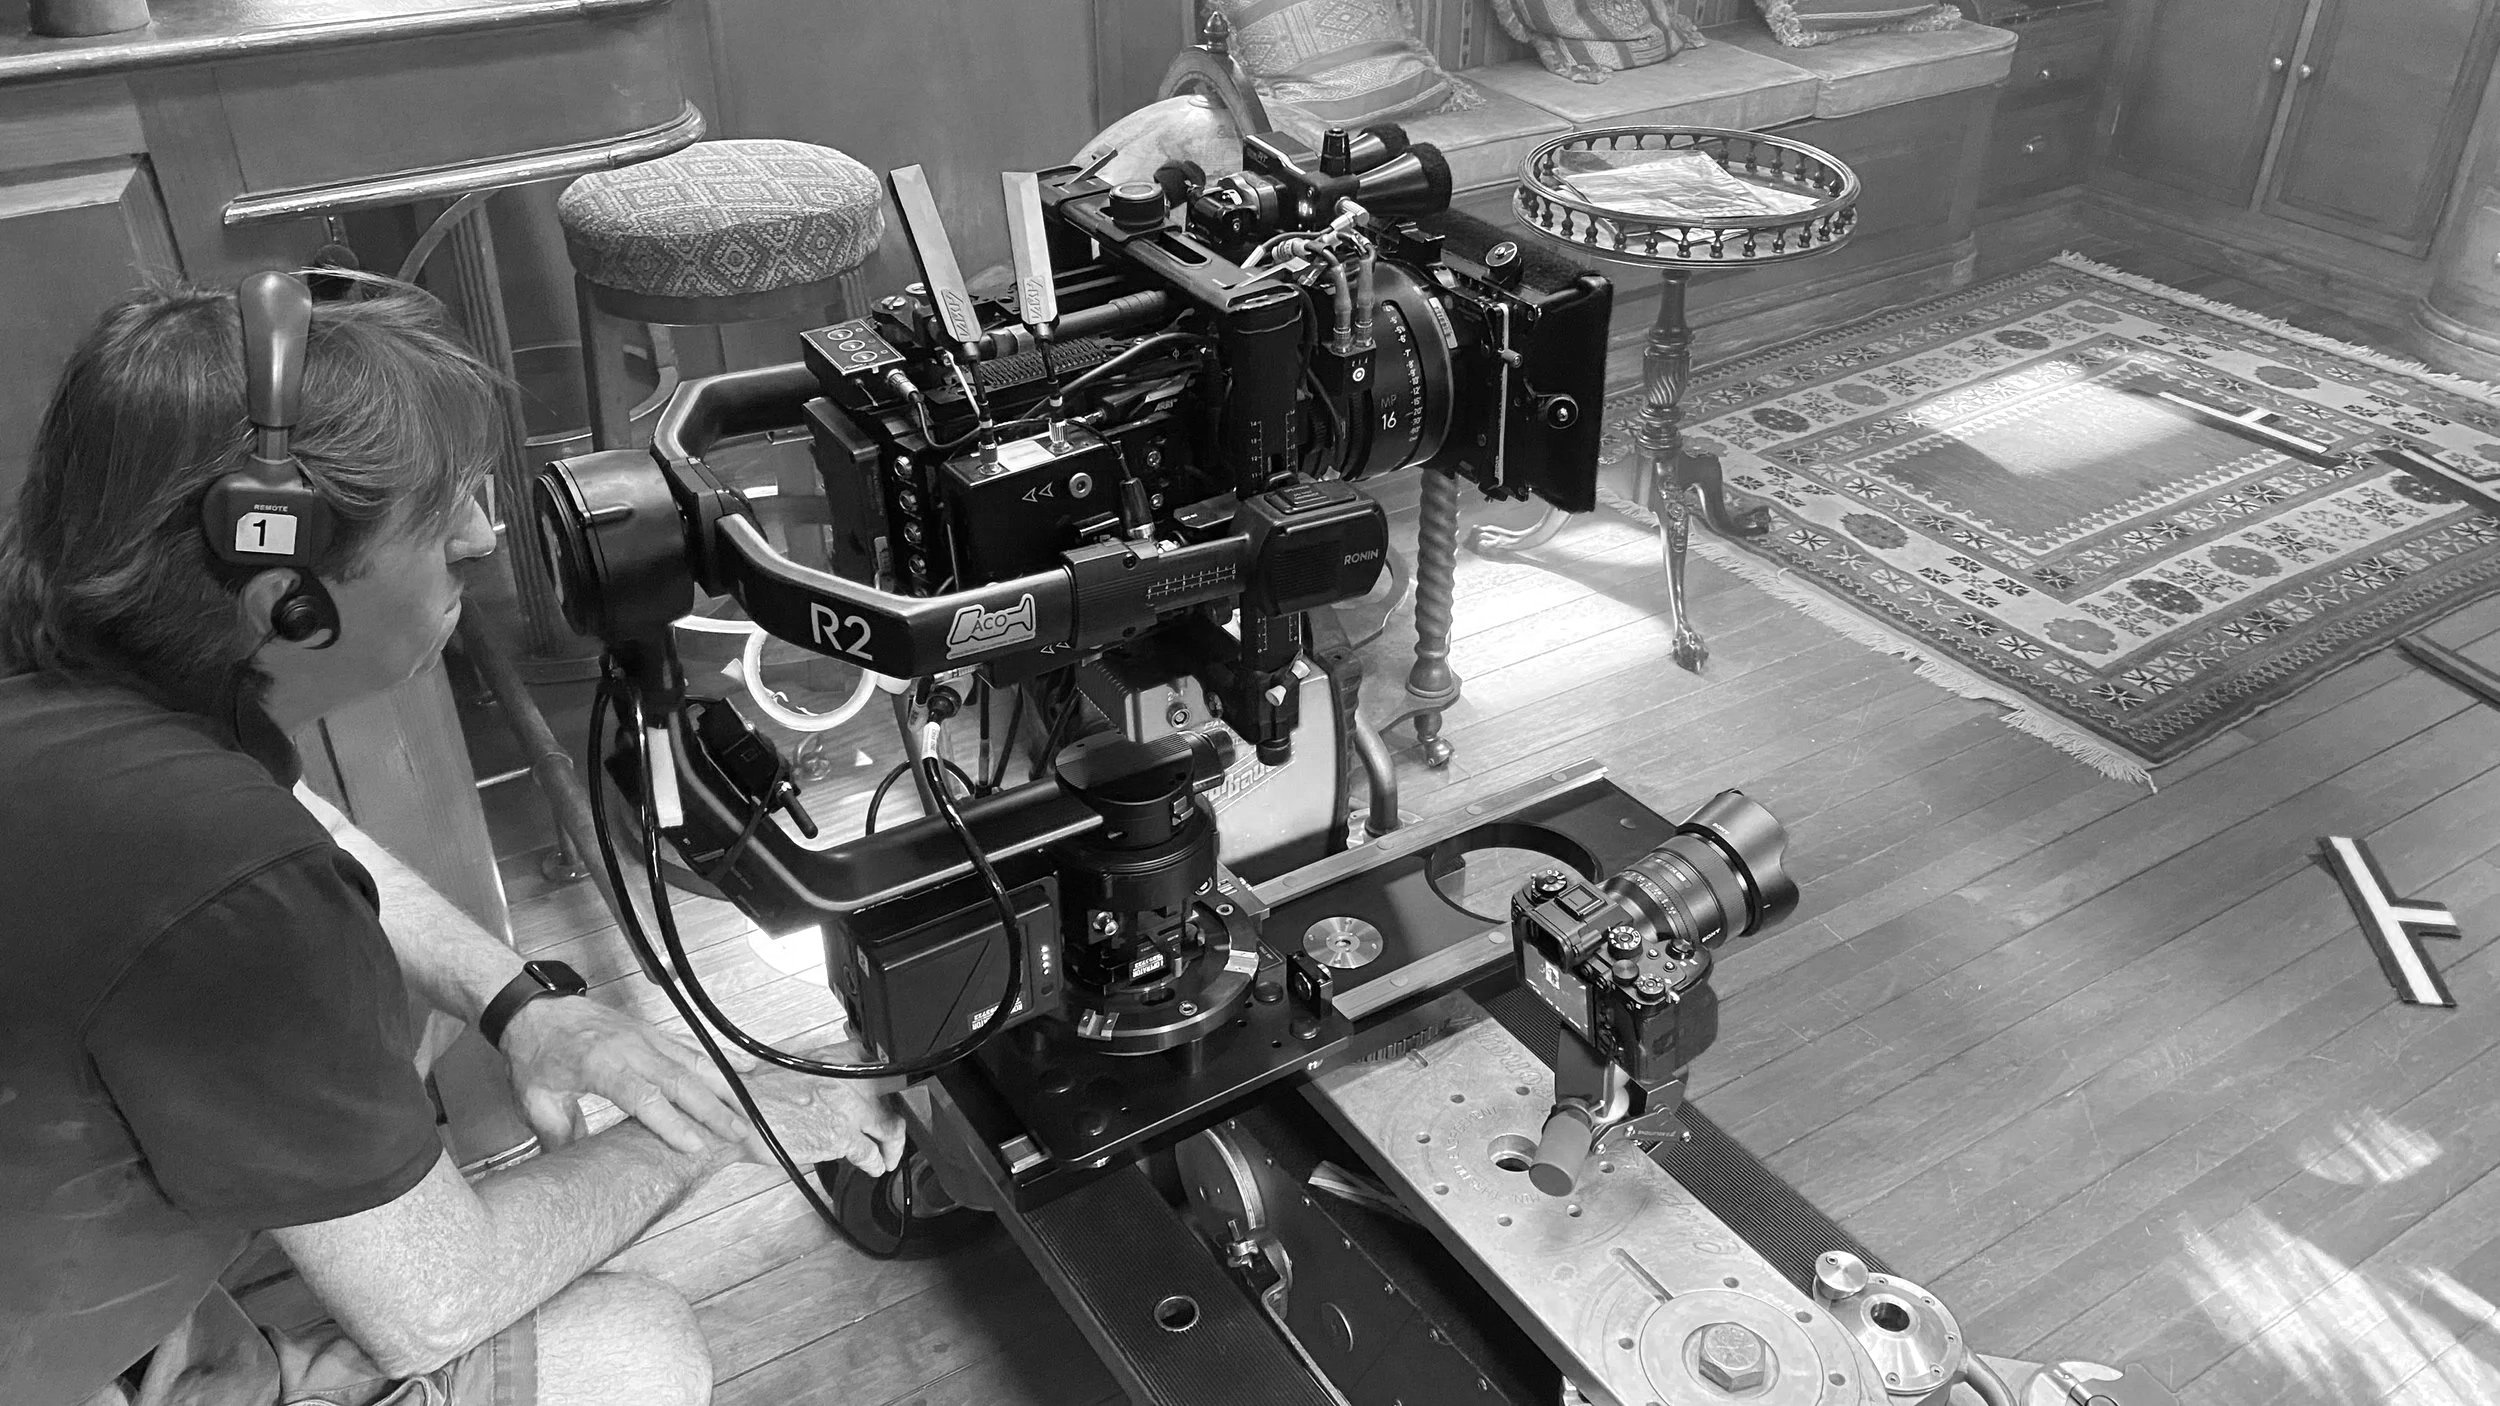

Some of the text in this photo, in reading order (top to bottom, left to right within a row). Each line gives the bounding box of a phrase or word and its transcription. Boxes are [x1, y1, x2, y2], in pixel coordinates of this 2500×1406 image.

[1381, 411, 1397, 430] 16
[254, 504, 288, 512] REMOTE
[253, 519, 266, 547] 1
[1344, 549, 1378, 566] RONIN
[810, 602, 873, 661] R2
[971, 613, 1008, 635] ACO
[1712, 822, 1730, 834] SONY
[1701, 927, 1721, 943] SONY
